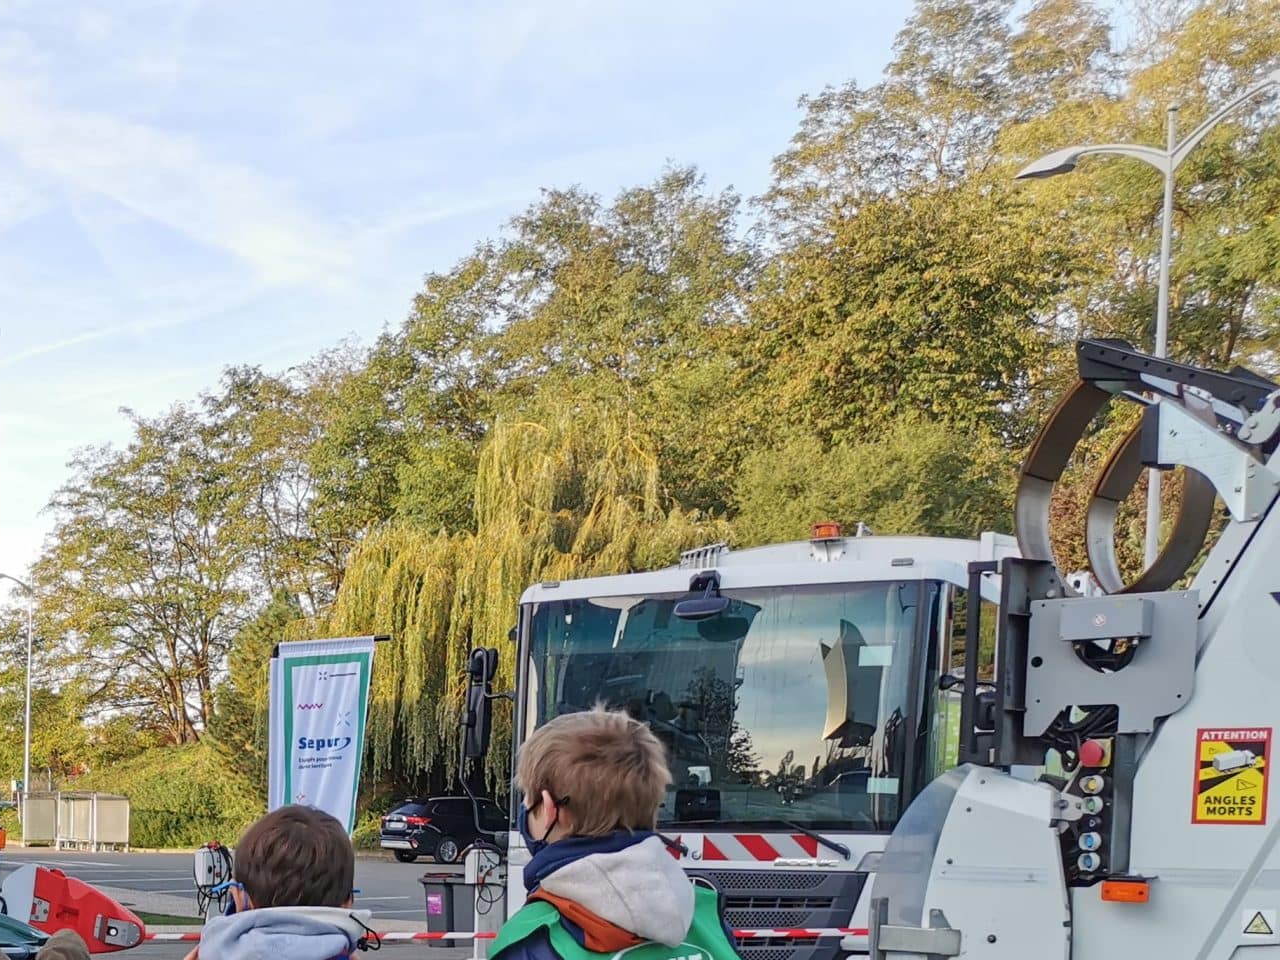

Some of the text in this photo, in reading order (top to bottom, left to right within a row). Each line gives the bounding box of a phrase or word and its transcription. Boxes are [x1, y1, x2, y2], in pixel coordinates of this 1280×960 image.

[1201, 730, 1268, 740] ATTENTION
[298, 736, 341, 751] Sepur
[1204, 796, 1256, 805] ANGLES
[1206, 806, 1253, 816] MORTS
